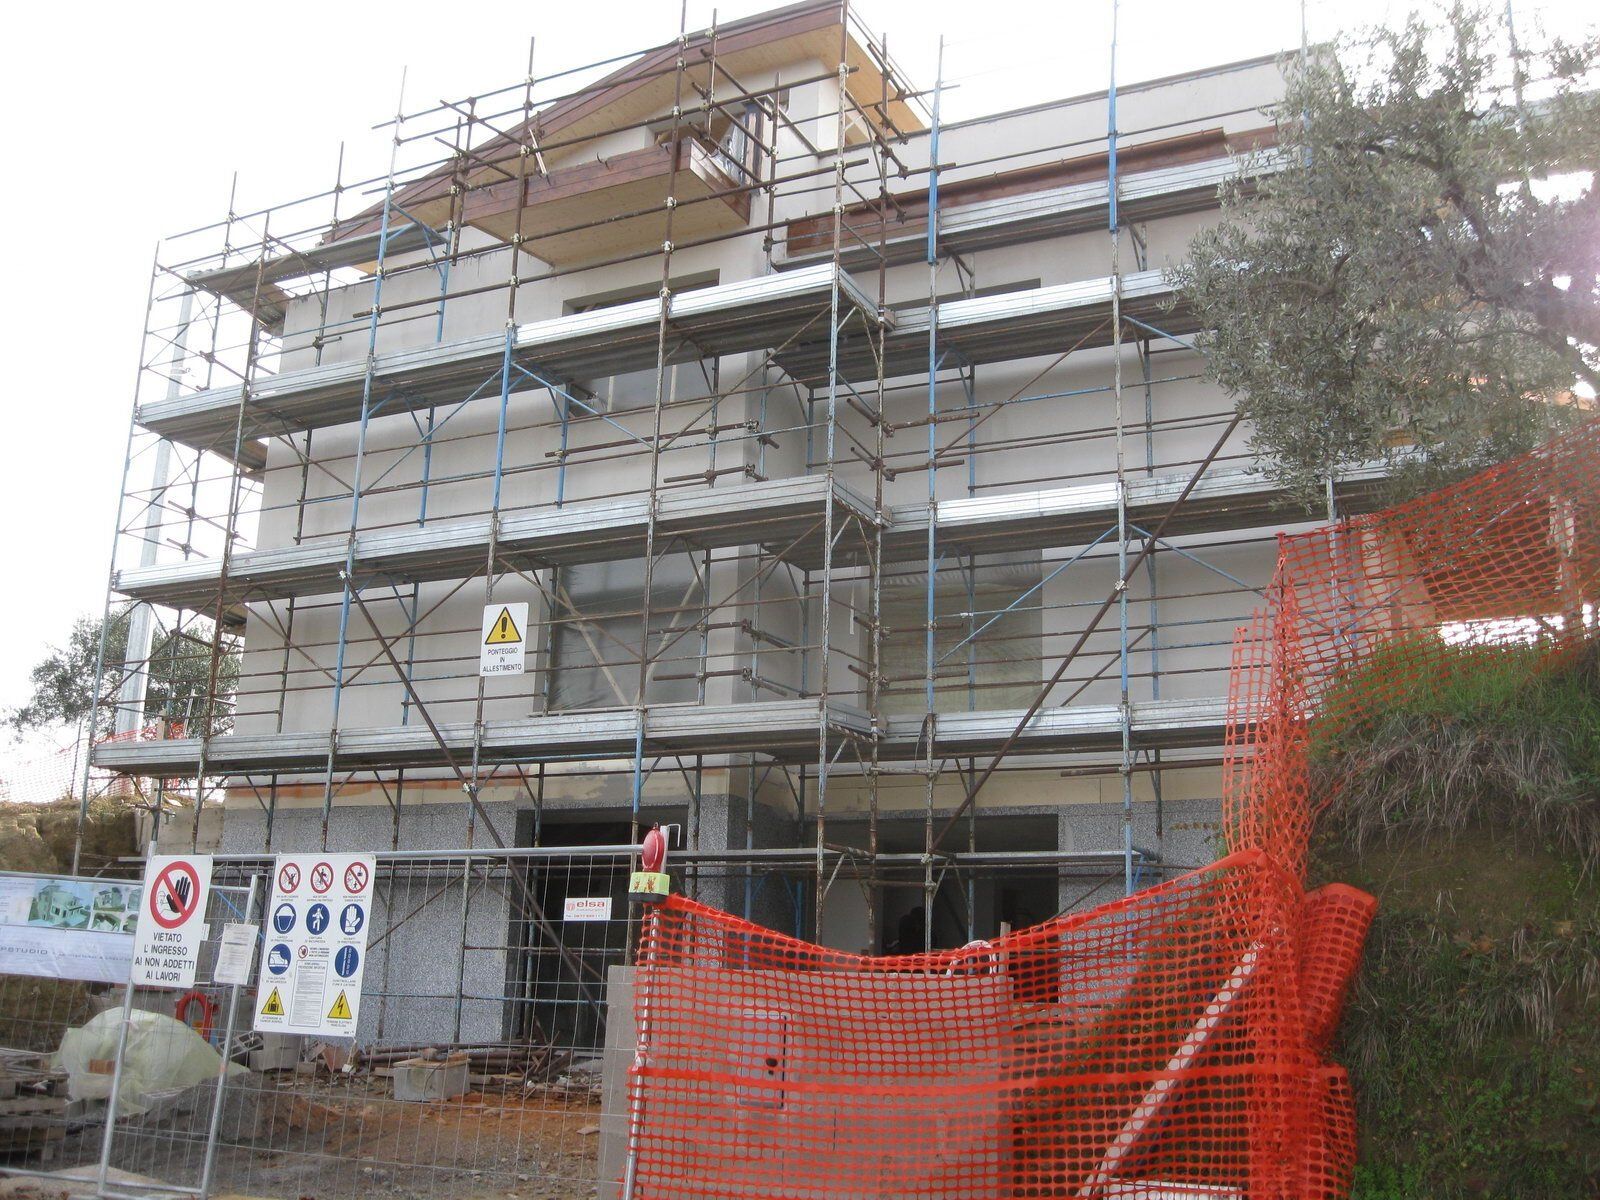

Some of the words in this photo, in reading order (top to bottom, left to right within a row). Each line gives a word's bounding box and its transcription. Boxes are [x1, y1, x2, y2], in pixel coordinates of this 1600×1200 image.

[487, 647, 518, 655] PONTEGGIO
[482, 663, 522, 673] ALLESTIMENTO
[153, 932, 182, 942] VIETATO
[150, 944, 188, 956] INGRESSO
[134, 956, 143, 965] AI
[144, 957, 160, 967] NON
[162, 959, 195, 970] ADDETTI
[145, 970, 153, 980] AI
[155, 971, 181, 982] LAVORI
